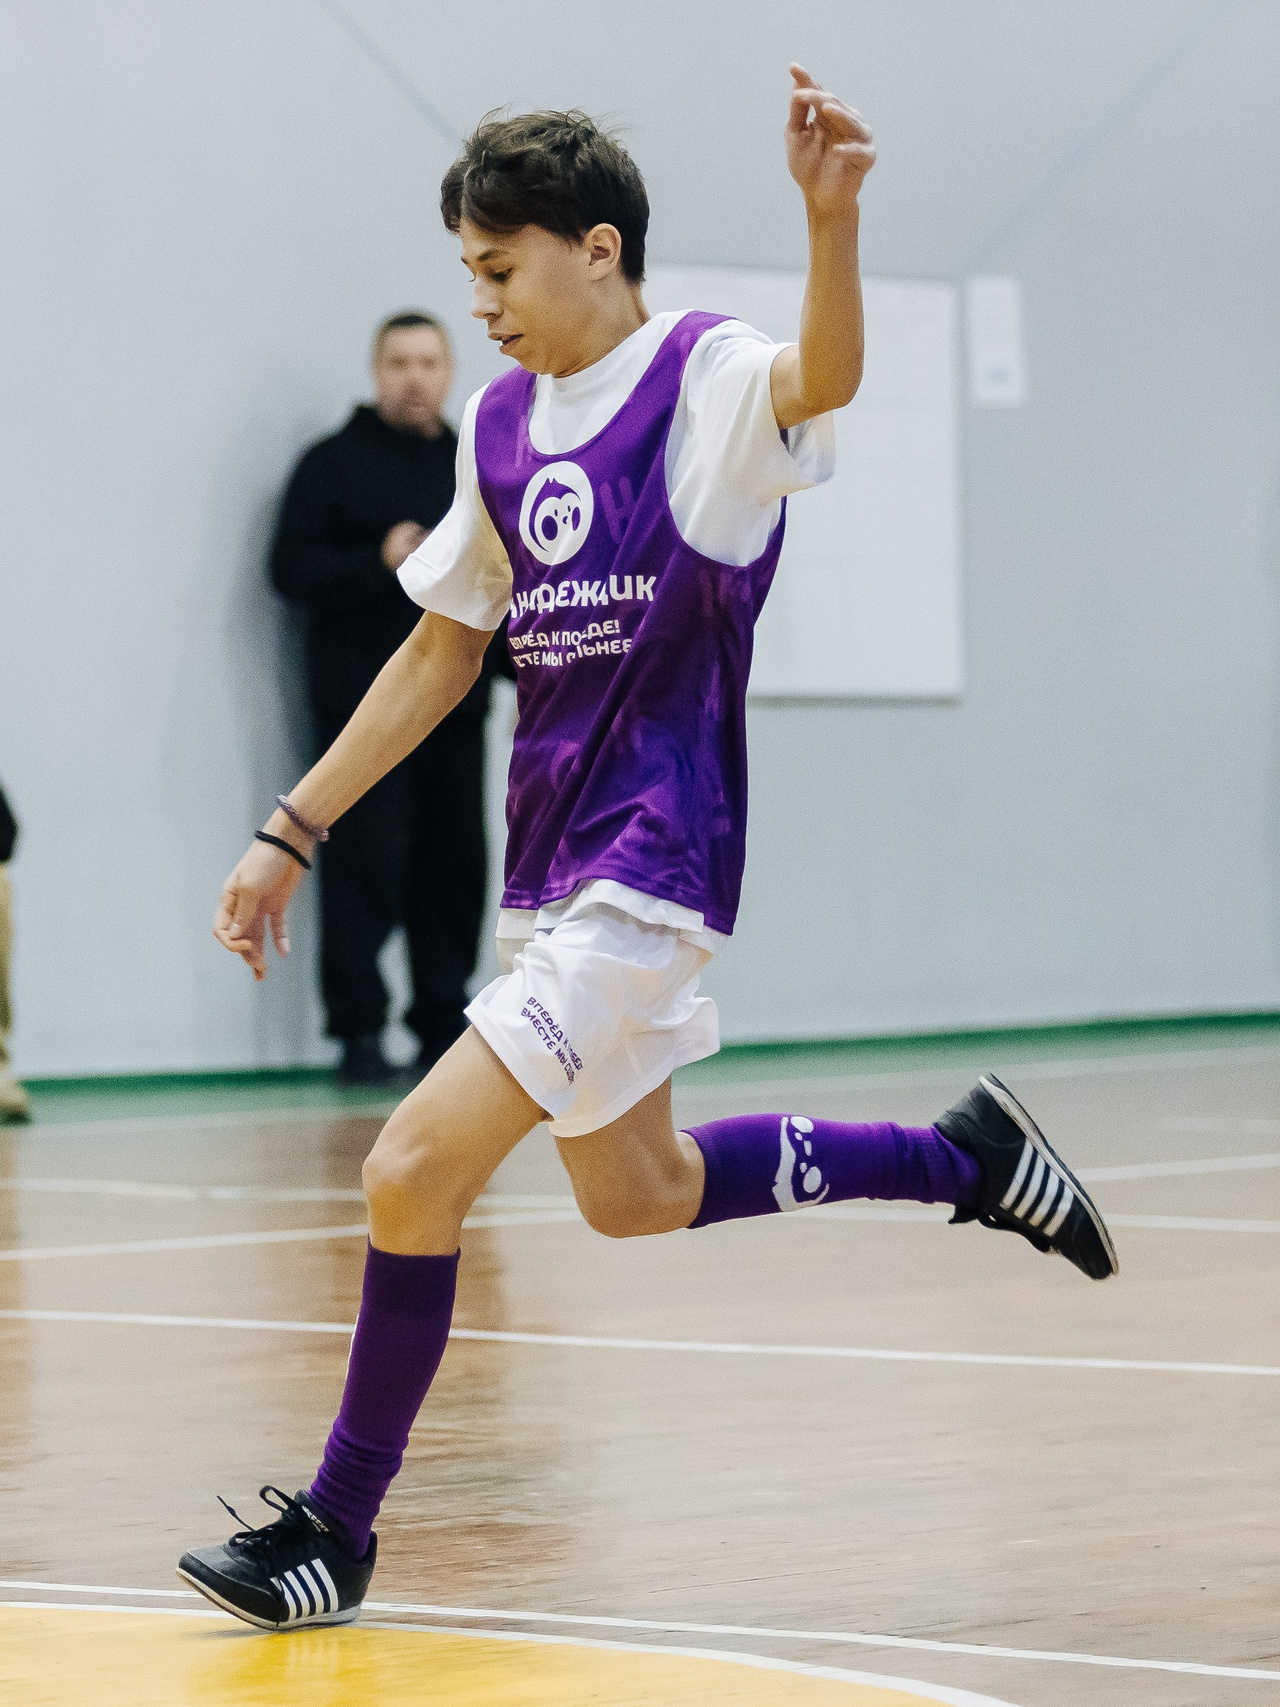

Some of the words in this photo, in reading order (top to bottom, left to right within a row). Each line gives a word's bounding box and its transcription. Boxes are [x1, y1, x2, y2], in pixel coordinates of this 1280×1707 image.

[551, 631, 560, 646] К
[541, 651, 564, 667] МЫ
[526, 996, 564, 1042] ВПЕРЁД
[521, 1007, 556, 1050] ВМЕСТЕ
[555, 1047, 568, 1065] МЫ
